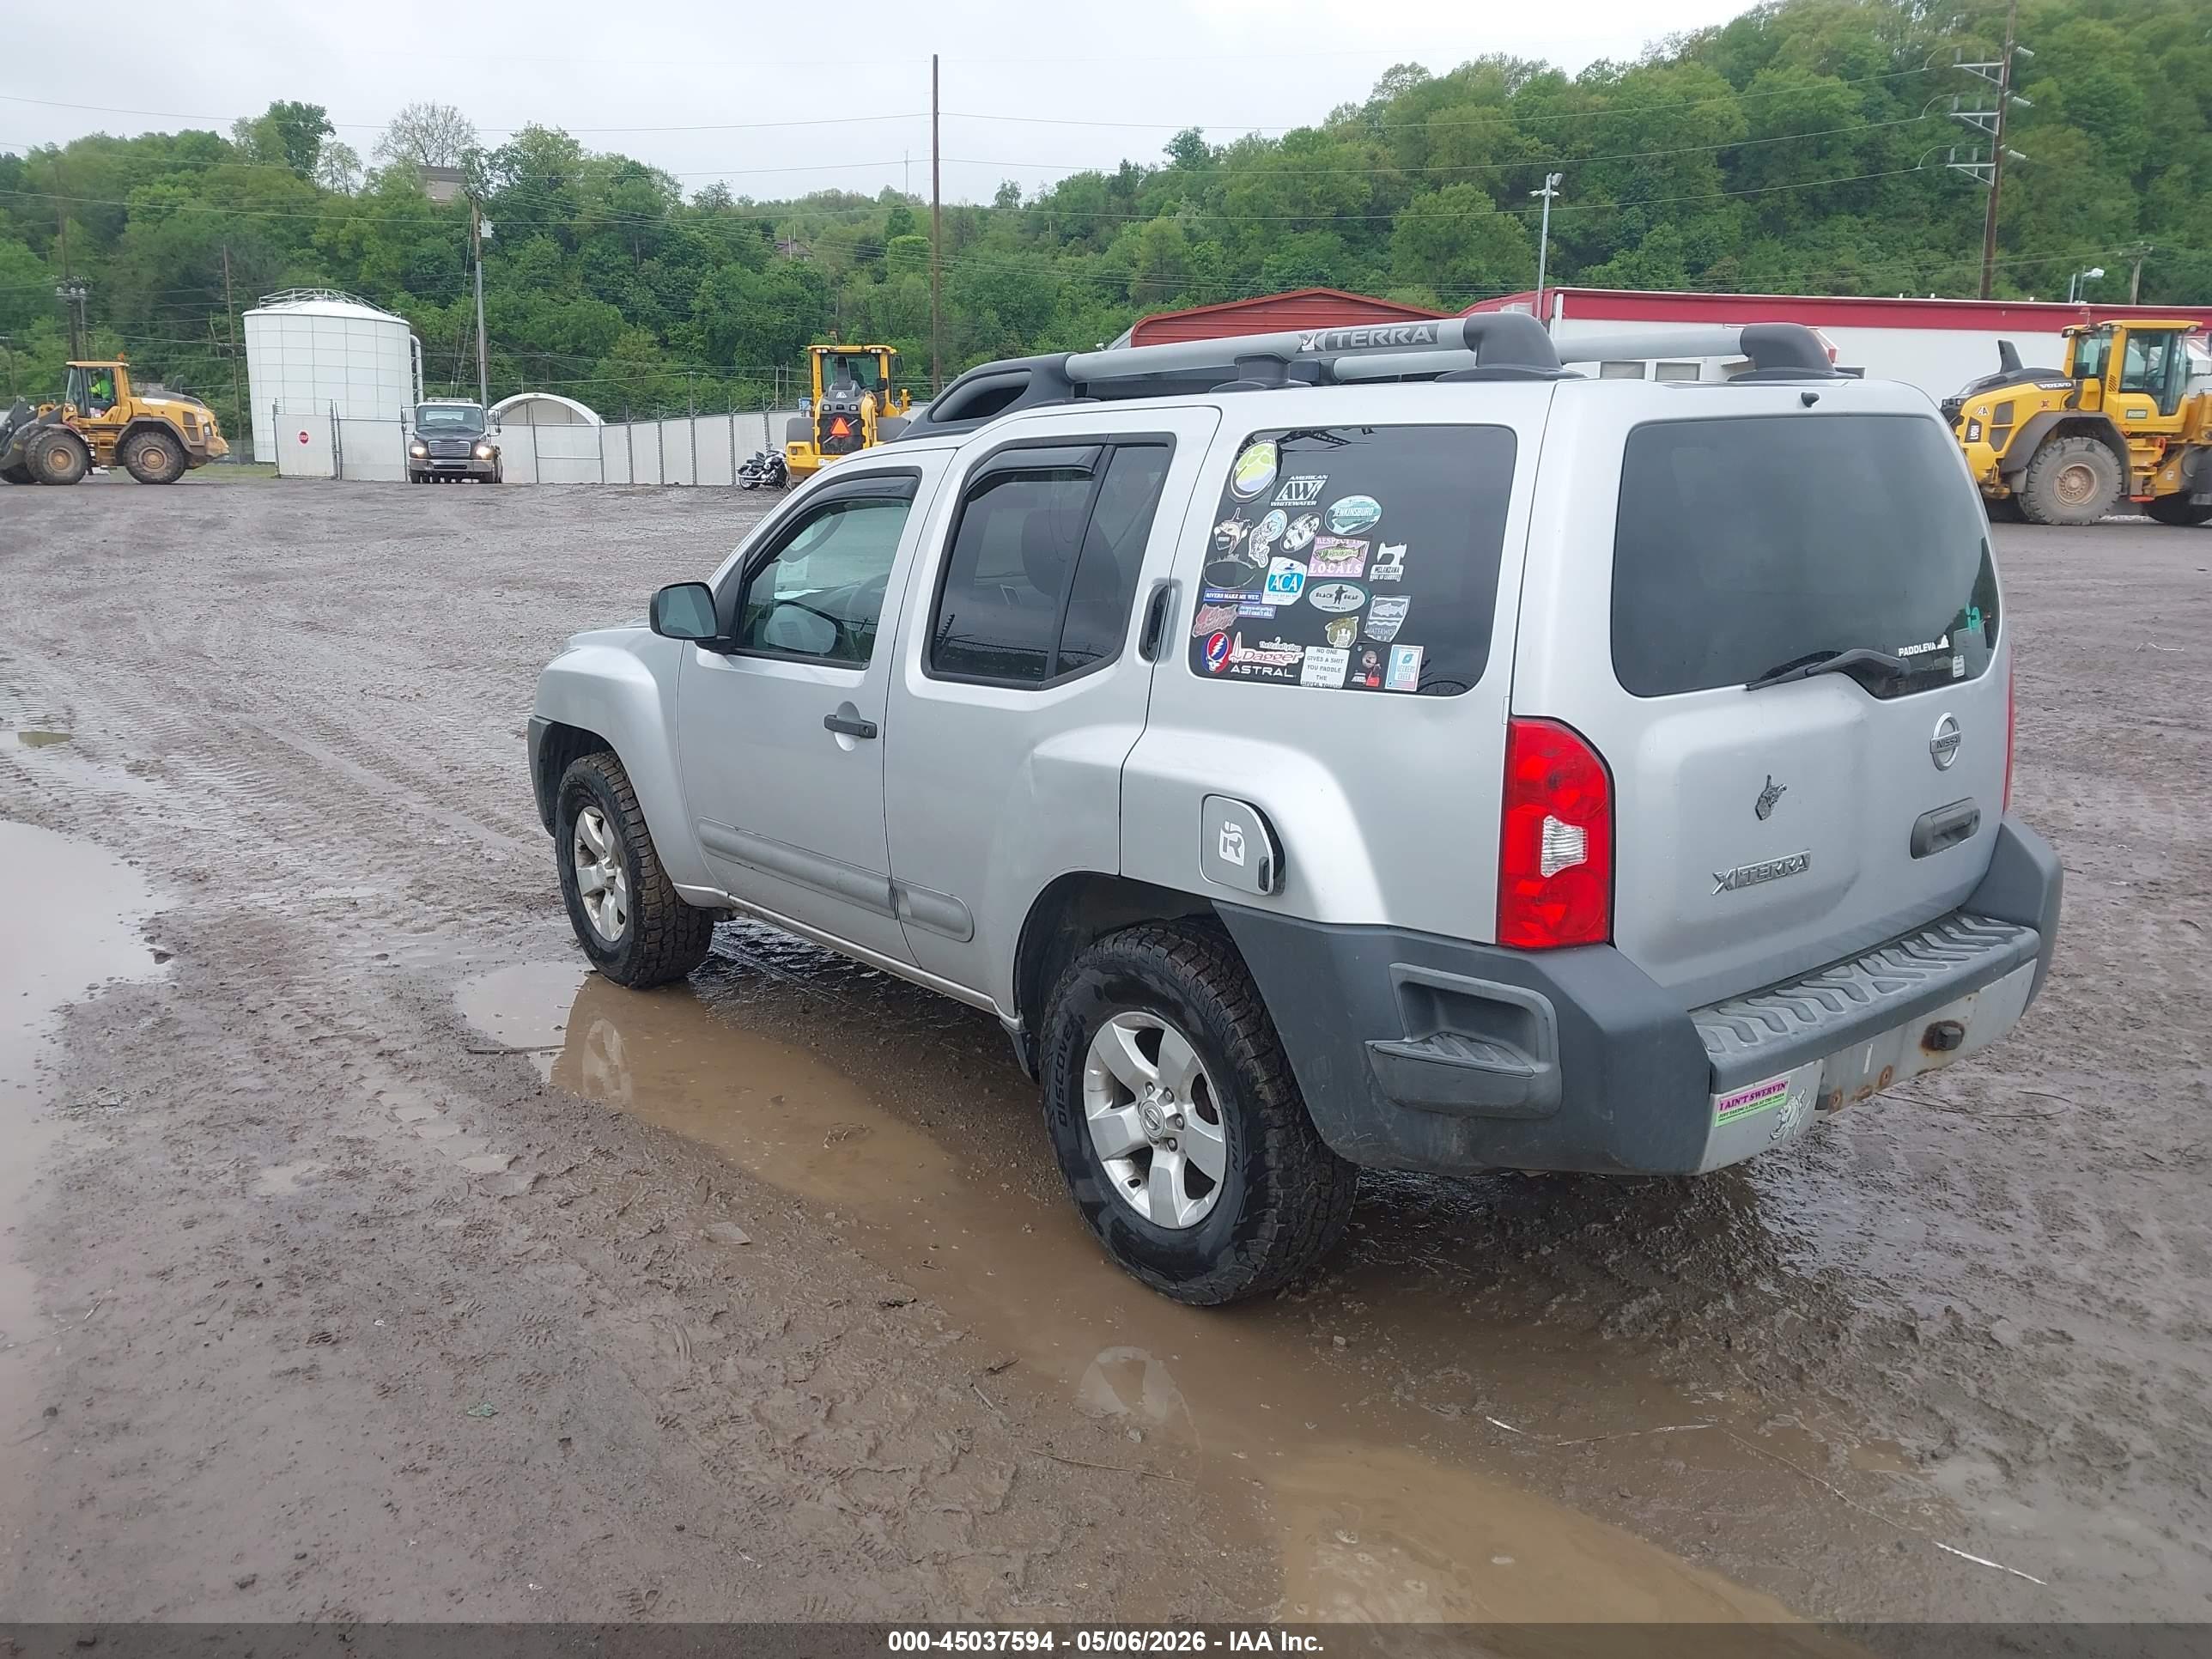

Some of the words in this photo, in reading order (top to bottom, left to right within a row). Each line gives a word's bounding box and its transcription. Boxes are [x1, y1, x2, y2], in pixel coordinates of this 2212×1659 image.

[1310, 562, 1363, 574] LOCALS
[1271, 574, 1298, 591] ACA
[1243, 650, 1302, 662] Dagger
[1898, 641, 1937, 657] PADDLEVA
[1231, 665, 1294, 678] ASTRAL
[1711, 852, 1809, 896] XTERRA
[1720, 1103, 1724, 1111] I
[1725, 1095, 1749, 1109] AIN'T
[1750, 1081, 1789, 1101] SWERVIN'
